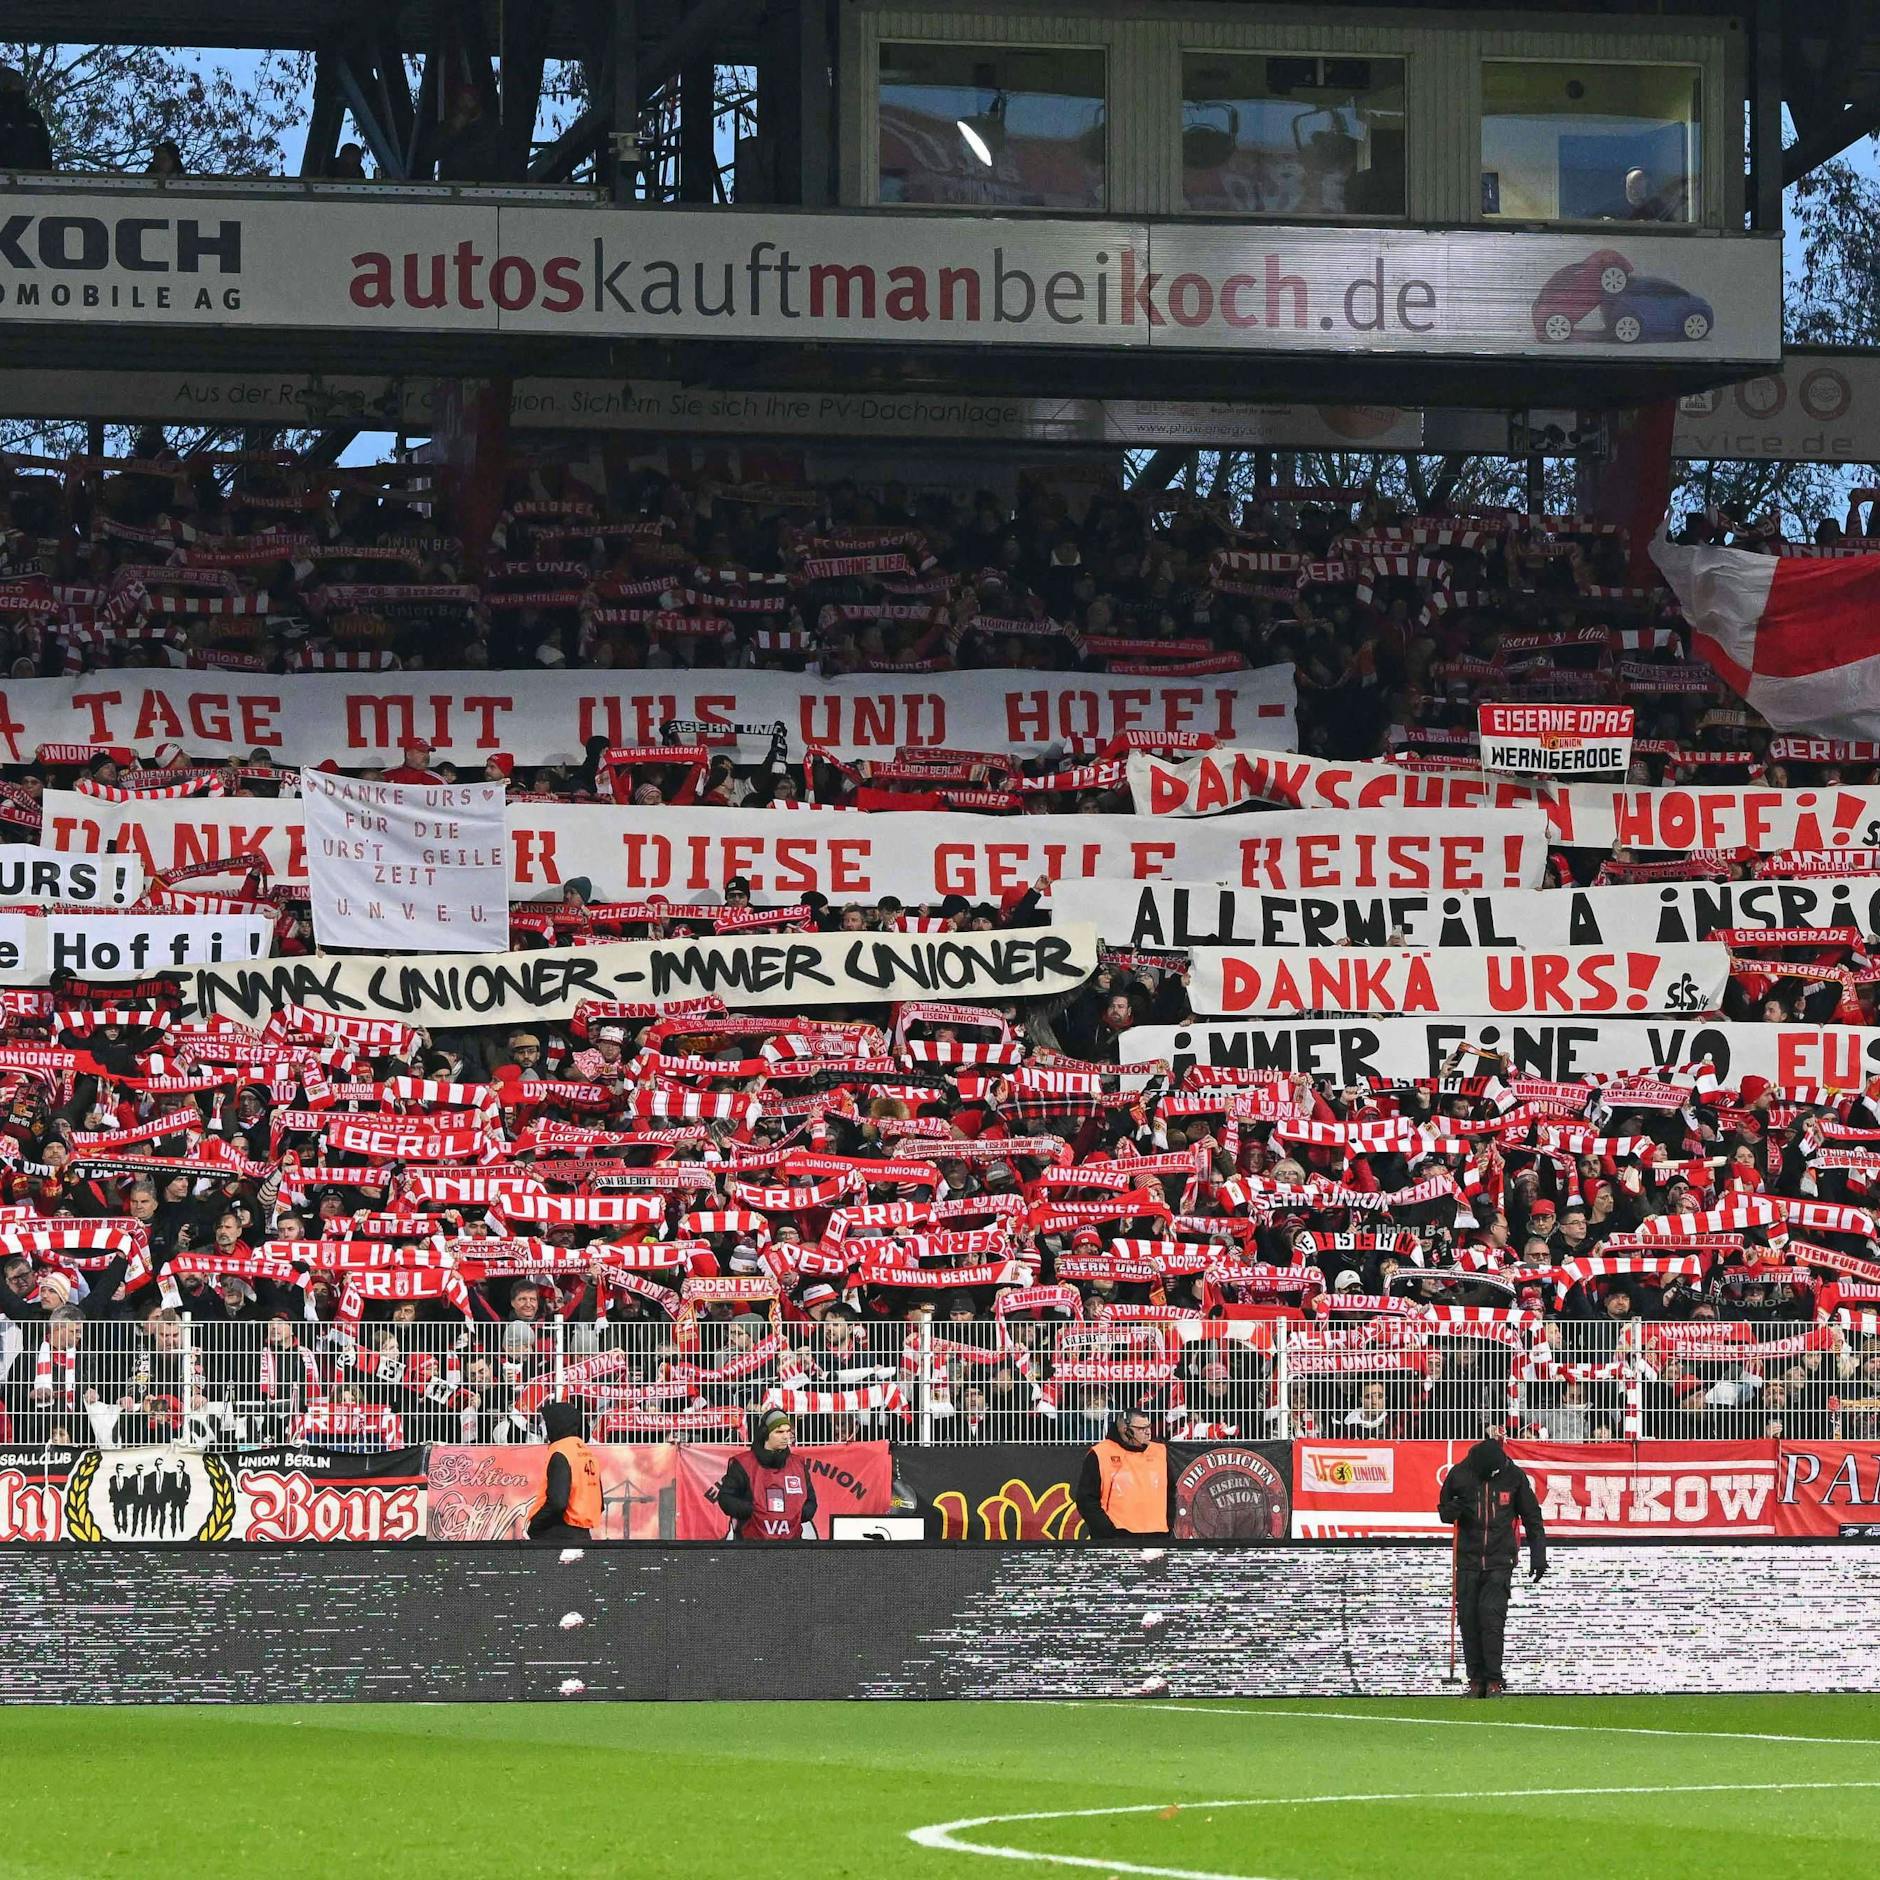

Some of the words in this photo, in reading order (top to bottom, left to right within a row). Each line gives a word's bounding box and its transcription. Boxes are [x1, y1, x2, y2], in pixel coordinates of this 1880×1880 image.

[349, 236, 1437, 332] autoskauftmanbeikoch.de
[0, 282, 170, 308] MOBILE
[194, 287, 241, 310] AG
[176, 383, 219, 402] Aus
[230, 383, 271, 403] der
[671, 396, 701, 415] Sie
[711, 396, 758, 417] sich
[766, 397, 810, 418] Ihre
[818, 398, 1018, 426] PV-Dachanlage
[619, 576, 678, 595] UNIONER
[72, 688, 283, 747] TAGE
[345, 695, 513, 749] MIT
[579, 696, 737, 748] URS
[801, 694, 945, 746] UND
[1493, 710, 1576, 732] EISERNE
[1579, 709, 1634, 733] OPAS
[1127, 730, 1199, 747] UNIONER
[1491, 748, 1622, 769] WERNIGERODE
[930, 764, 962, 777] BERLIN
[325, 778, 403, 806] DANKE
[426, 790, 472, 808] URS
[345, 811, 389, 834] FÜR
[414, 821, 459, 840] DIE
[423, 849, 502, 866] GEILE
[623, 833, 872, 892] DIESE
[1240, 834, 1524, 890] REISE!
[375, 866, 437, 886] ZEIT
[337, 898, 352, 918] U.
[369, 899, 386, 919] N.
[402, 900, 415, 921] V.
[438, 904, 452, 923] E.
[471, 906, 488, 924] U.
[1569, 893, 1604, 946] A
[1735, 929, 1848, 943] GEGENGERADE
[53, 931, 261, 971] Hoffi!
[370, 955, 616, 1014] UNIONER
[651, 945, 835, 998] IMMER
[845, 936, 1086, 989] UNIONER
[1221, 952, 1440, 1012] DANKÄ
[1487, 952, 1661, 1012] URS!
[919, 1004, 955, 1014] NIEMALS
[922, 1012, 948, 1022] EISERN
[950, 1013, 980, 1024] UNION
[659, 1056, 740, 1072] UNIONER
[1053, 1056, 1101, 1073] EISERN
[1106, 1060, 1151, 1074] UNION
[1646, 1028, 1732, 1086] VO
[770, 1062, 792, 1074] FC
[1213, 1068, 1233, 1082] FC
[1236, 1069, 1283, 1083] Union
[148, 1075, 224, 1088] UNIONER
[341, 1083, 374, 1094] UNION
[1516, 1083, 1558, 1097] UNION
[9, 1114, 31, 1128] Berlin
[1821, 1122, 1846, 1136] NUR
[72, 1129, 100, 1144] NUR
[102, 1126, 129, 1142] FÜR
[806, 1159, 853, 1171] UNIONER
[884, 1165, 930, 1177] UNIONER
[1117, 1157, 1157, 1171] UNION
[617, 1176, 653, 1187] BLEIBT
[656, 1177, 676, 1187] ROT
[1048, 1167, 1127, 1188] UNIONER
[502, 1196, 660, 1222] UNION
[1051, 1202, 1139, 1214] UNIONER
[1376, 1223, 1420, 1237] Union
[1642, 1234, 1689, 1246] UNION
[178, 1256, 292, 1277] UNIONER
[484, 1268, 514, 1277] STADION
[514, 1260, 555, 1269] UNION
[1058, 1259, 1111, 1274] EISERN
[872, 1268, 890, 1281] FC
[893, 1269, 938, 1283] UNION
[941, 1267, 992, 1283] BERLIN
[1014, 1288, 1059, 1303] UNION
[1117, 1305, 1142, 1318] FÜR
[1676, 1341, 1732, 1356] EISERN
[1744, 1337, 1805, 1353] UNION
[1345, 1352, 1399, 1370] UNION
[580, 1385, 596, 1396] FC
[602, 1384, 641, 1397] Union
[646, 1383, 688, 1396] Berlin
[637, 1415, 675, 1426] UNION
[679, 1413, 722, 1426] BERLIN
[238, 1453, 281, 1468] UNION
[284, 1453, 331, 1469] BERLIN
[427, 1453, 529, 1488] Sektion
[1183, 1469, 1200, 1490] DIE
[1204, 1452, 1276, 1486] ÜBLICHEN
[1353, 1466, 1388, 1482] UNION
[1209, 1478, 1251, 1496] EISERN
[236, 1470, 421, 1542] Boys
[1216, 1491, 1262, 1508] UNION
[1528, 1473, 1775, 1523] ANKOW
[763, 1519, 791, 1536] VA
